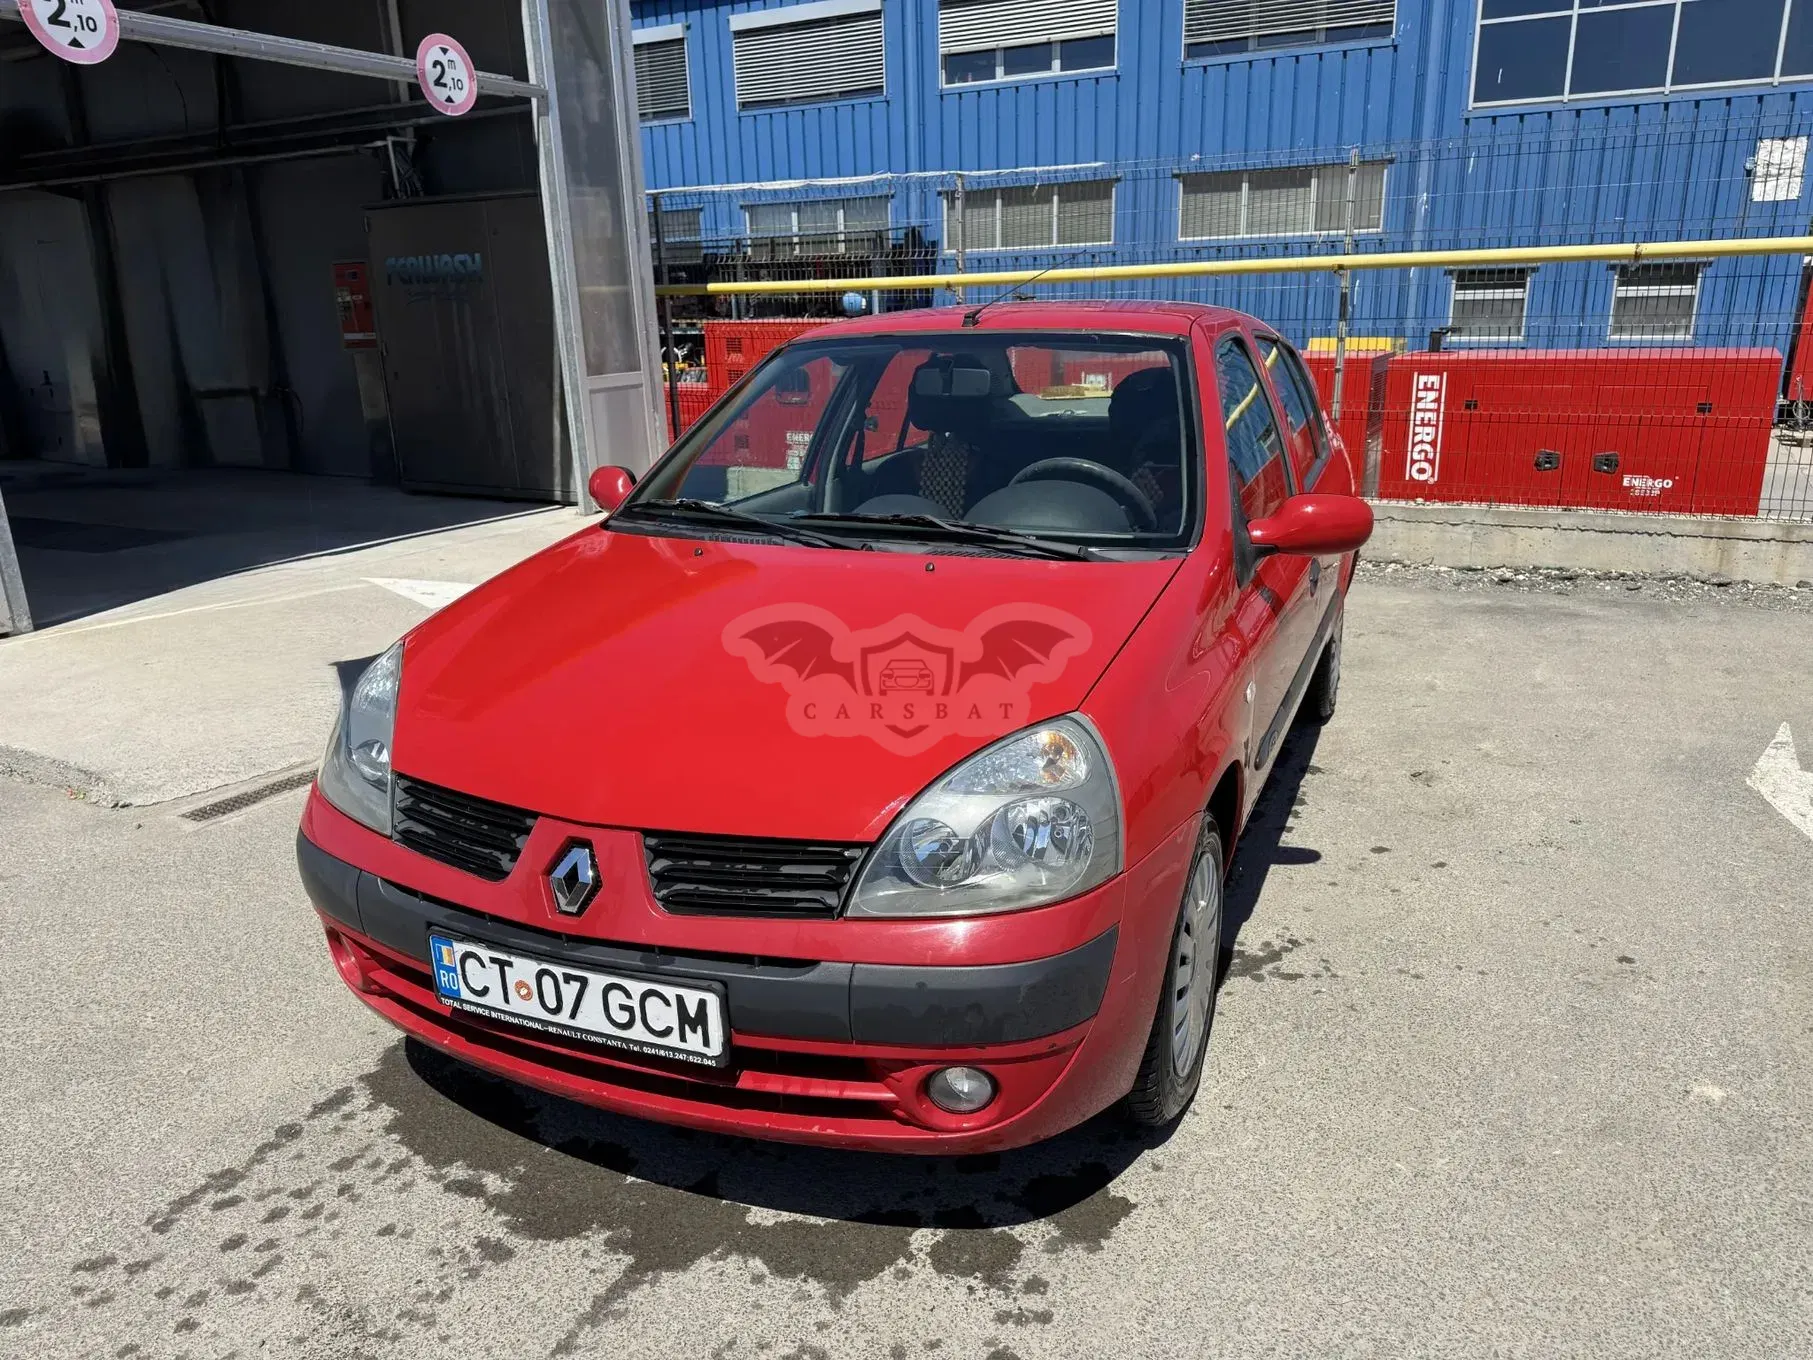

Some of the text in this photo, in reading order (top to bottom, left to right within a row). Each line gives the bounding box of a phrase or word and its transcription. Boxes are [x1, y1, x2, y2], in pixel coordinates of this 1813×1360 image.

[1411, 375, 1441, 482] ENERGO
[1623, 477, 1673, 488] ENERGO
[440, 969, 459, 991] RO
[460, 950, 711, 1049] CT 07 GCM
[440, 997, 462, 1010] TOTAL
[463, 1002, 490, 1017] SERVICE
[582, 1033, 628, 1050] CONSTANTA
[629, 1043, 642, 1053] Tel.
